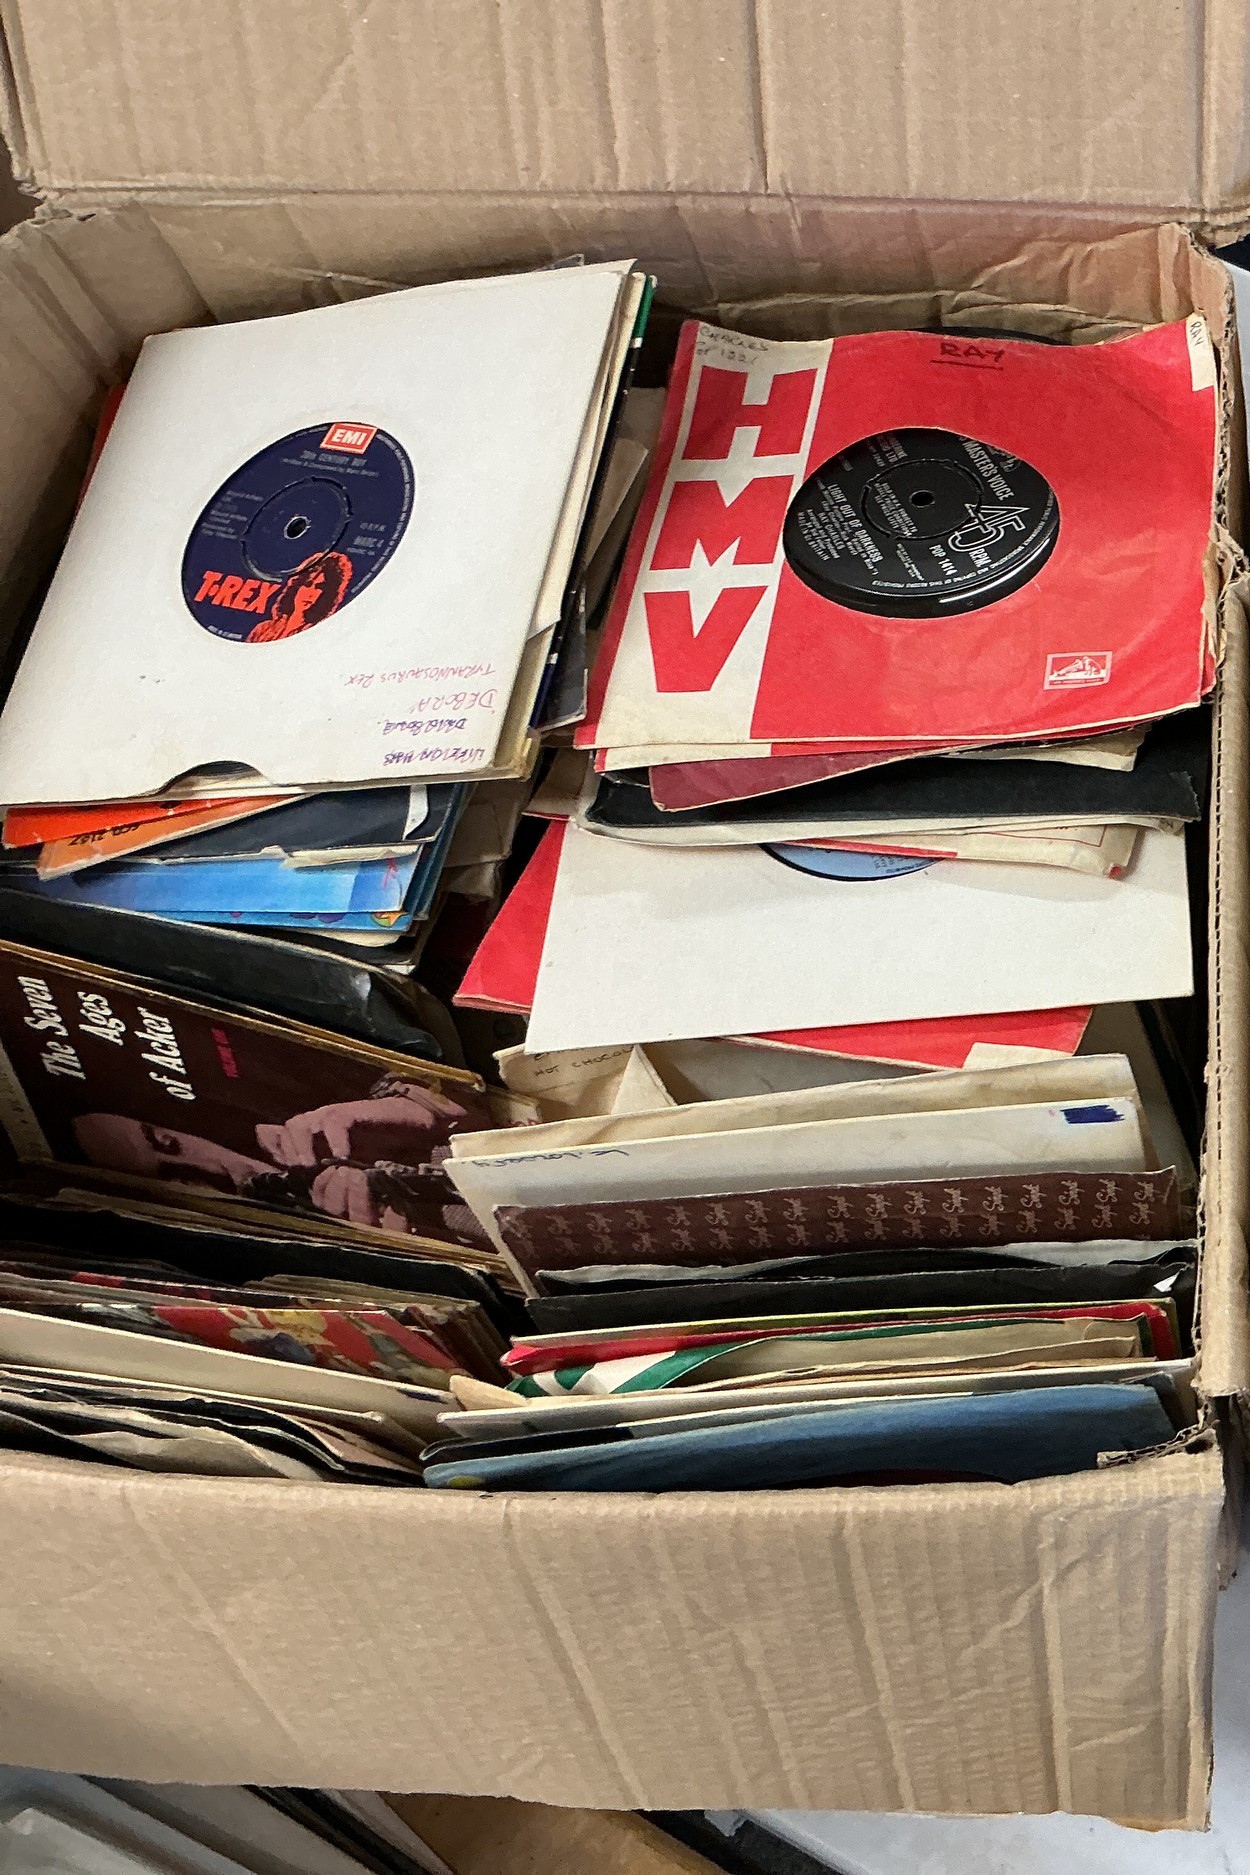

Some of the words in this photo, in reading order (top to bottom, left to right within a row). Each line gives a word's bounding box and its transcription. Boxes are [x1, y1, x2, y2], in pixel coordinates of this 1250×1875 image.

[1188, 320, 1207, 347] RAY
[938, 342, 1005, 363] RAY
[330, 428, 368, 446] EMI
[827, 484, 848, 504] LIGHT
[986, 472, 1015, 501] VOICE
[840, 504, 856, 518] OUT
[848, 518, 863, 528] OF
[643, 365, 817, 694] HMV
[818, 512, 830, 524] RAY
[824, 524, 846, 550] CHARLES
[948, 503, 1031, 552] 45
[853, 529, 884, 563] DARKNESS
[928, 544, 946, 558] POP
[938, 558, 958, 576] 1414
[16, 975, 70, 1038] Seven
[76, 991, 127, 1047] Ages
[134, 1006, 188, 1076] Acker
[40, 1040, 87, 1080] The
[535, 1064, 560, 1077] HOT
[148, 1071, 197, 1101] of
